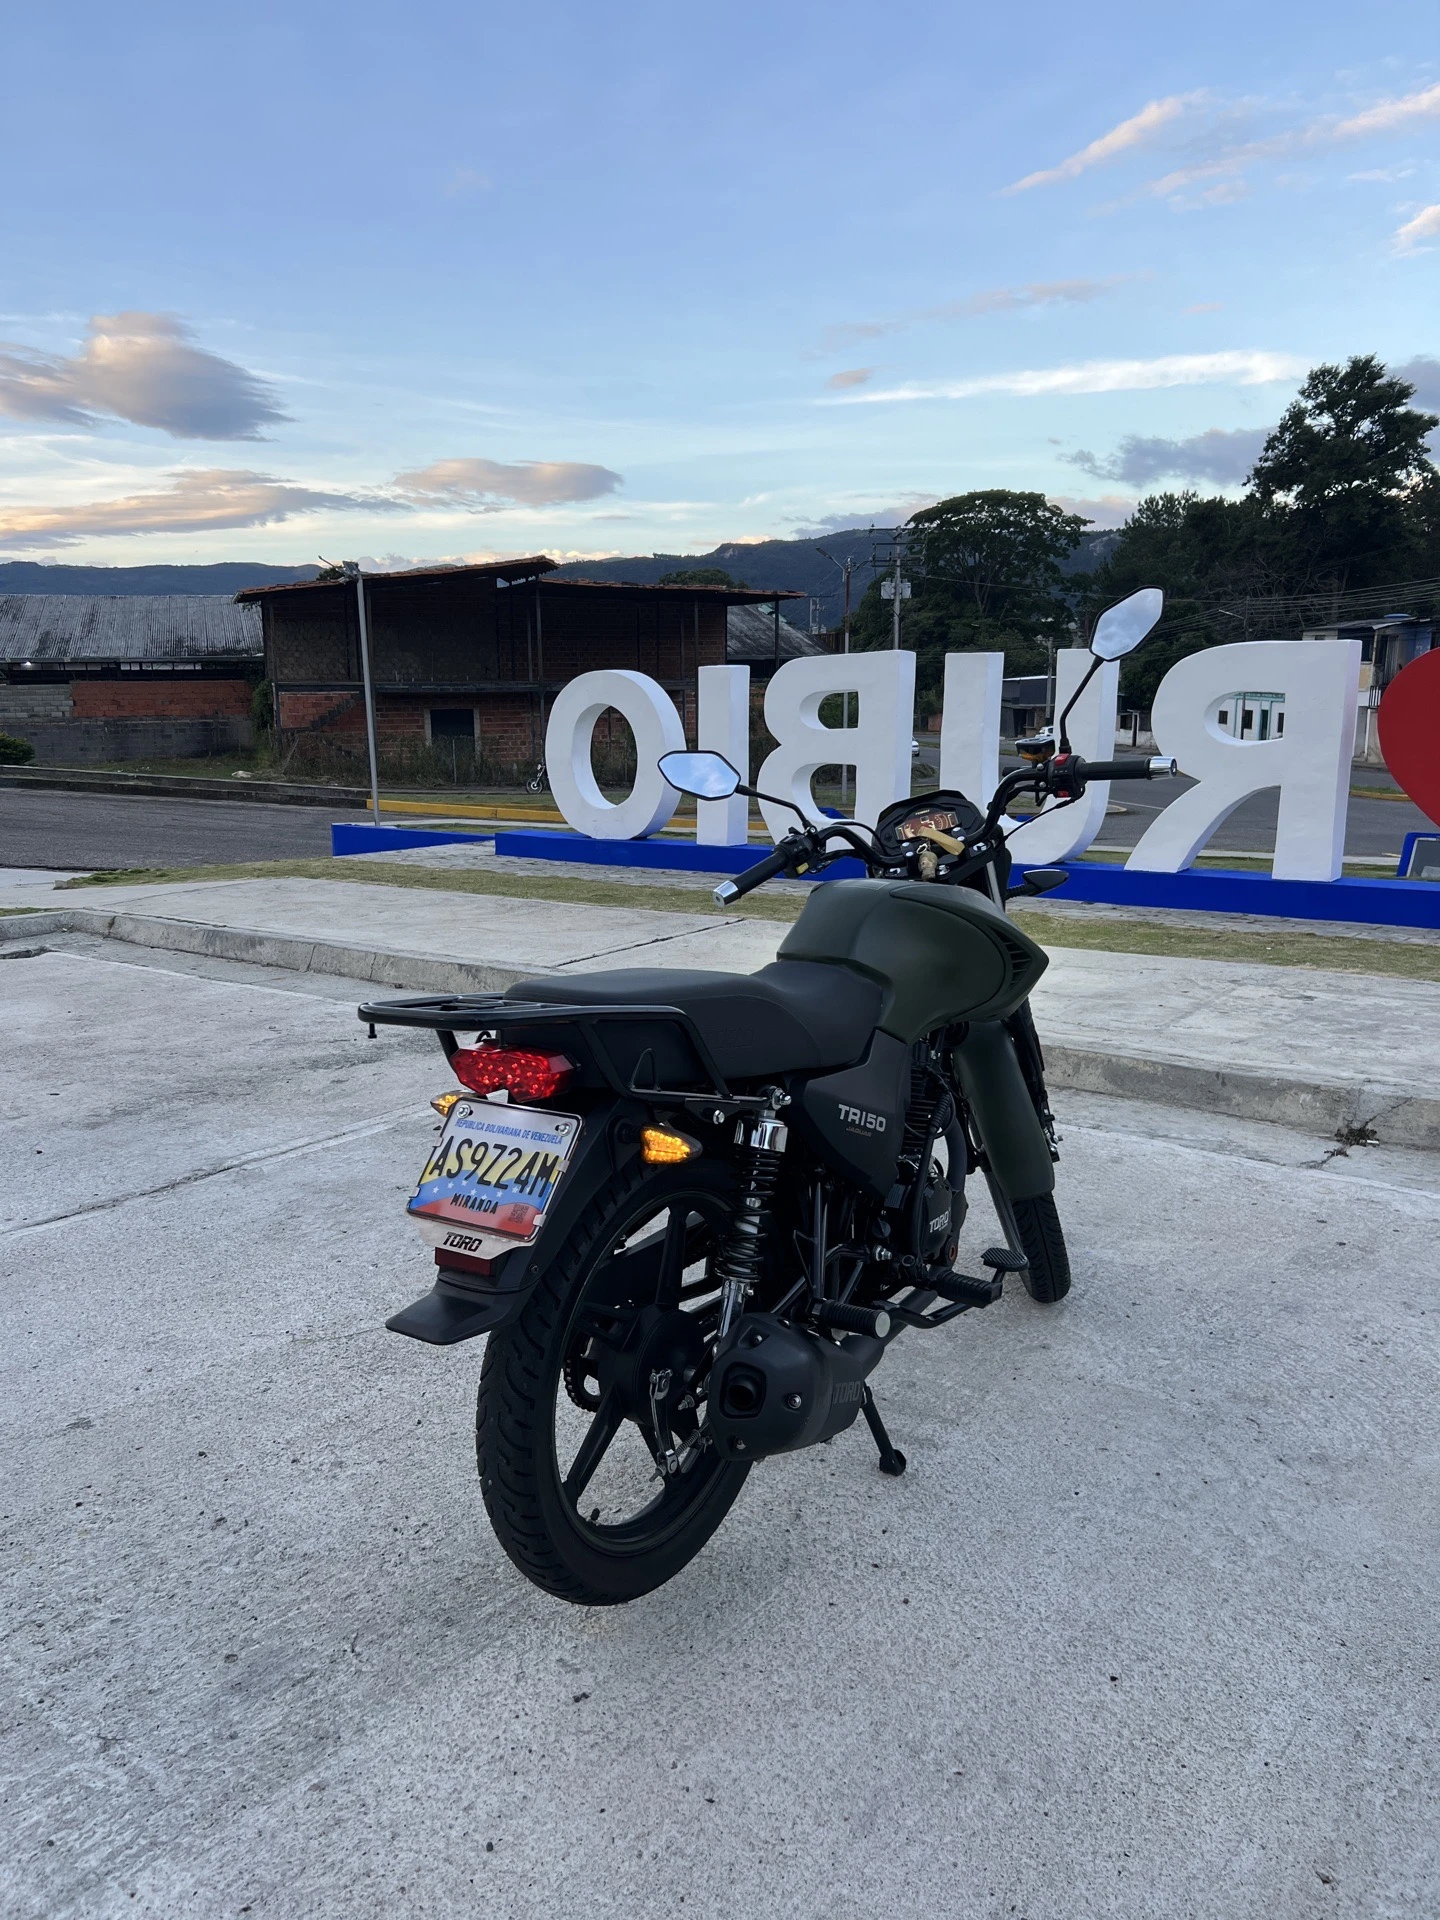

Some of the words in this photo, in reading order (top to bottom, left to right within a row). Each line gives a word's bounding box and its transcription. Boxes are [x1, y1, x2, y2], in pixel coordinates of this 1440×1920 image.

[838, 1103, 886, 1132] TR150
[484, 1126, 521, 1138] BOLIVARIANA
[521, 1131, 531, 1139] DE
[531, 1132, 562, 1145] VENEZUELA
[428, 1135, 560, 1198] AS9Z24M
[450, 1193, 499, 1215] MIRANDA
[929, 1210, 949, 1233] TORO
[442, 1231, 483, 1252] TORO
[832, 1380, 861, 1404] TORO
